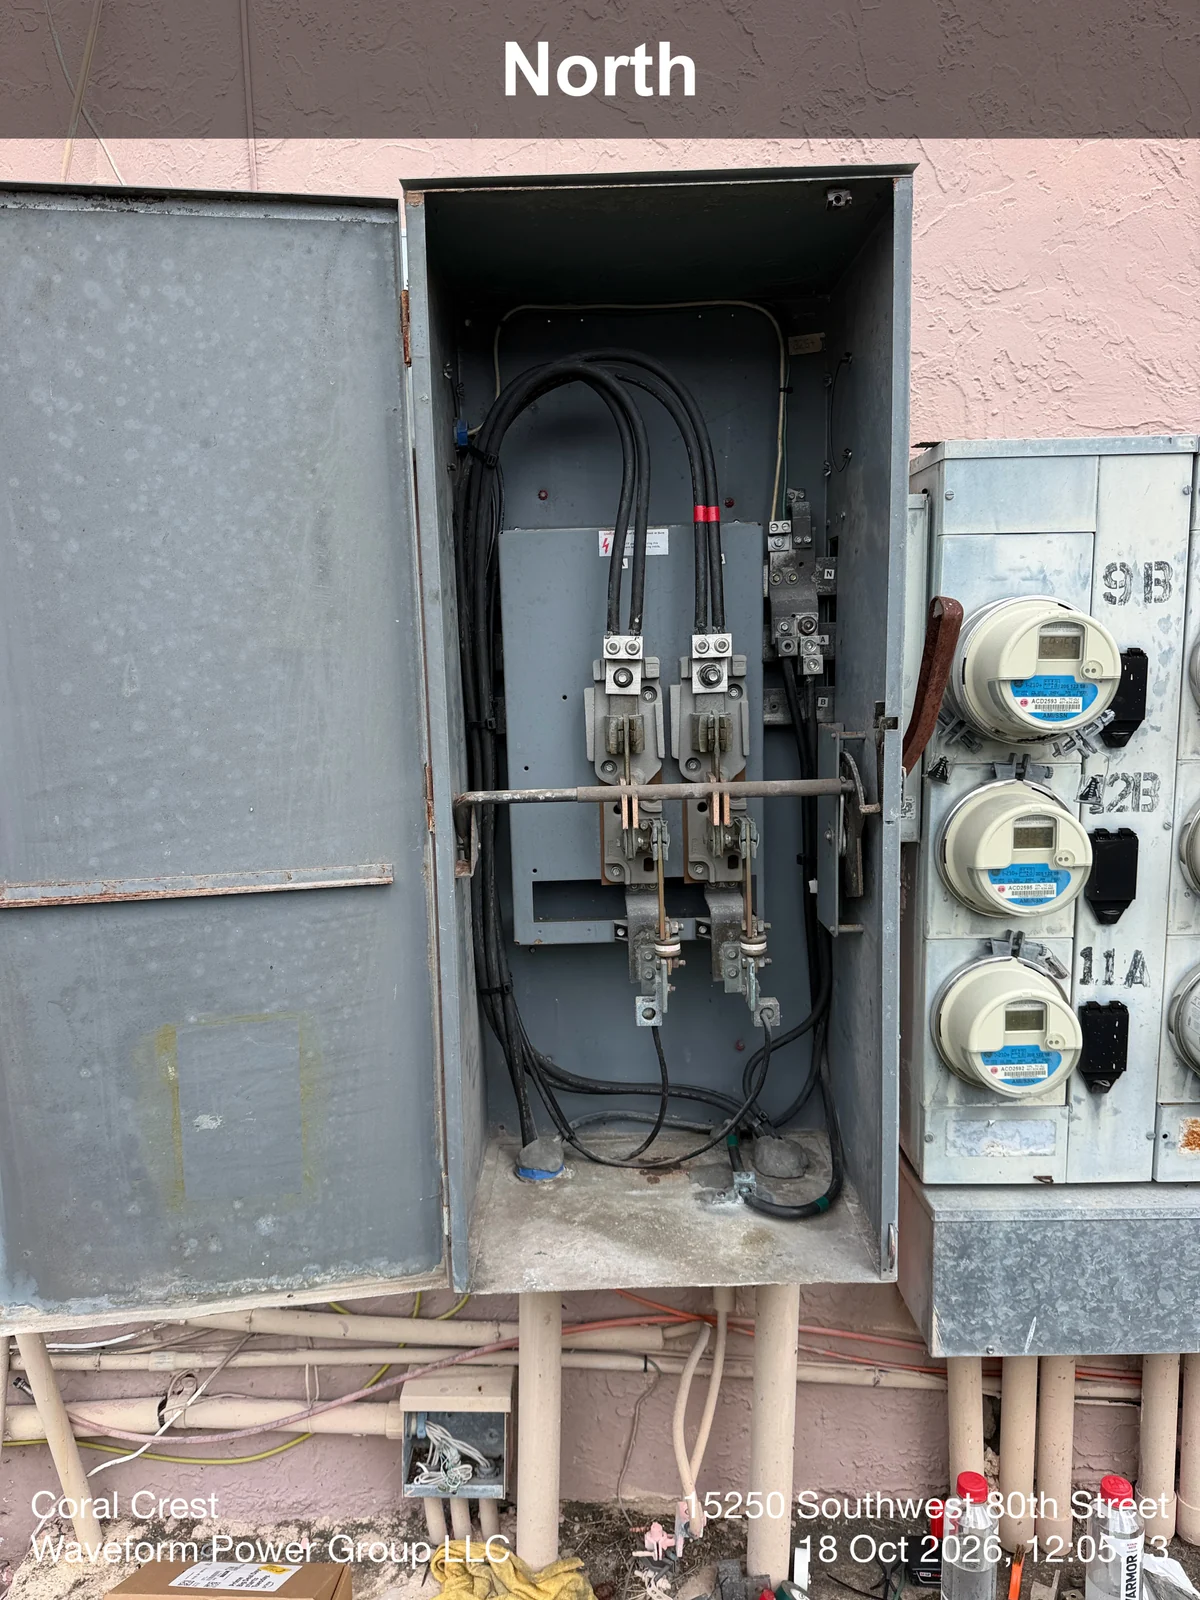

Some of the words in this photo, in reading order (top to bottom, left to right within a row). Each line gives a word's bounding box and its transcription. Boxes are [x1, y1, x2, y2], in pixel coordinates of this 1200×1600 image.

[826, 570, 833, 578] N
[1102, 560, 1174, 606] 9B
[820, 698, 827, 706] B
[1079, 946, 1151, 989] 11A
[1124, 1553, 1138, 1600] ARMOR
